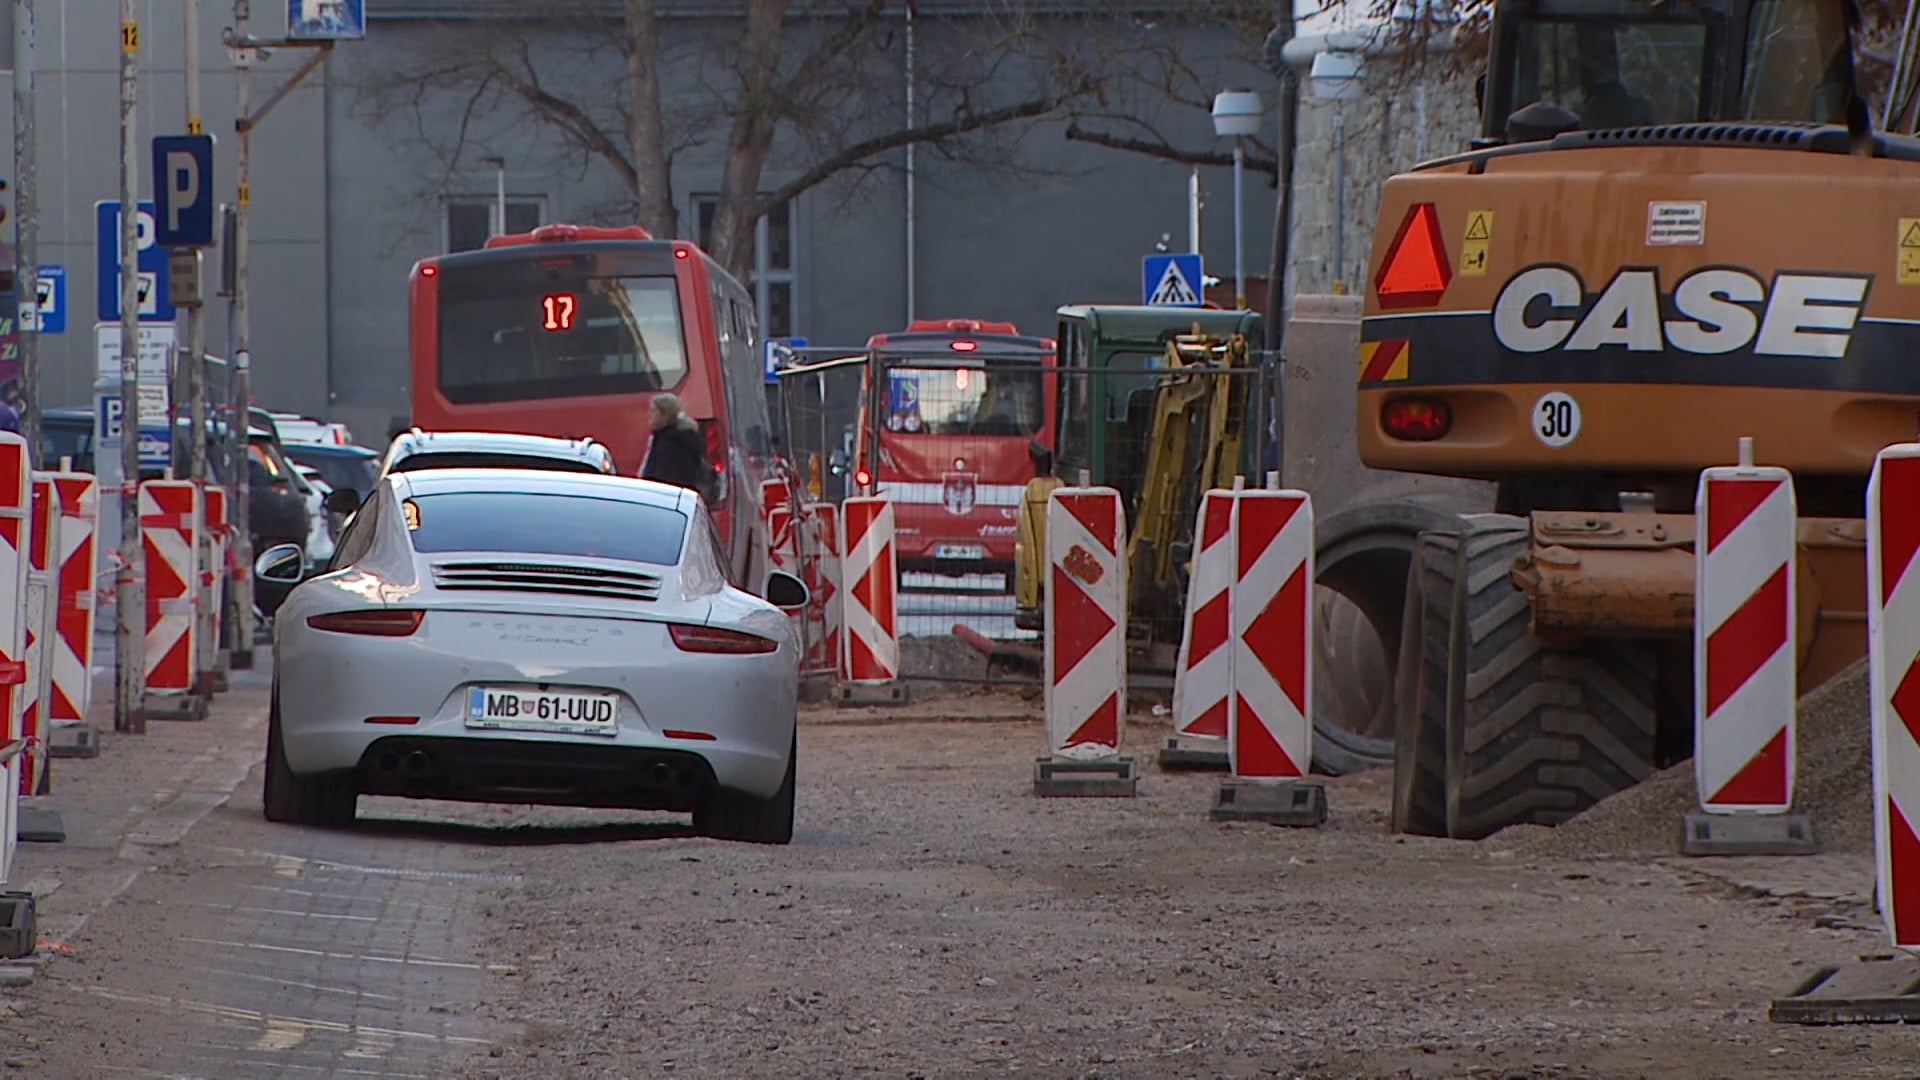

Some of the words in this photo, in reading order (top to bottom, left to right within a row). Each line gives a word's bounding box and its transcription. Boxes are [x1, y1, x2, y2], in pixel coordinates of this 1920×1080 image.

[122, 26, 137, 46] 12
[167, 152, 199, 231] P
[543, 296, 573, 329] 17
[1494, 267, 1869, 358] CASE
[1541, 400, 1572, 438] 30
[487, 694, 519, 718] MB
[537, 696, 612, 722] 61-UUD
